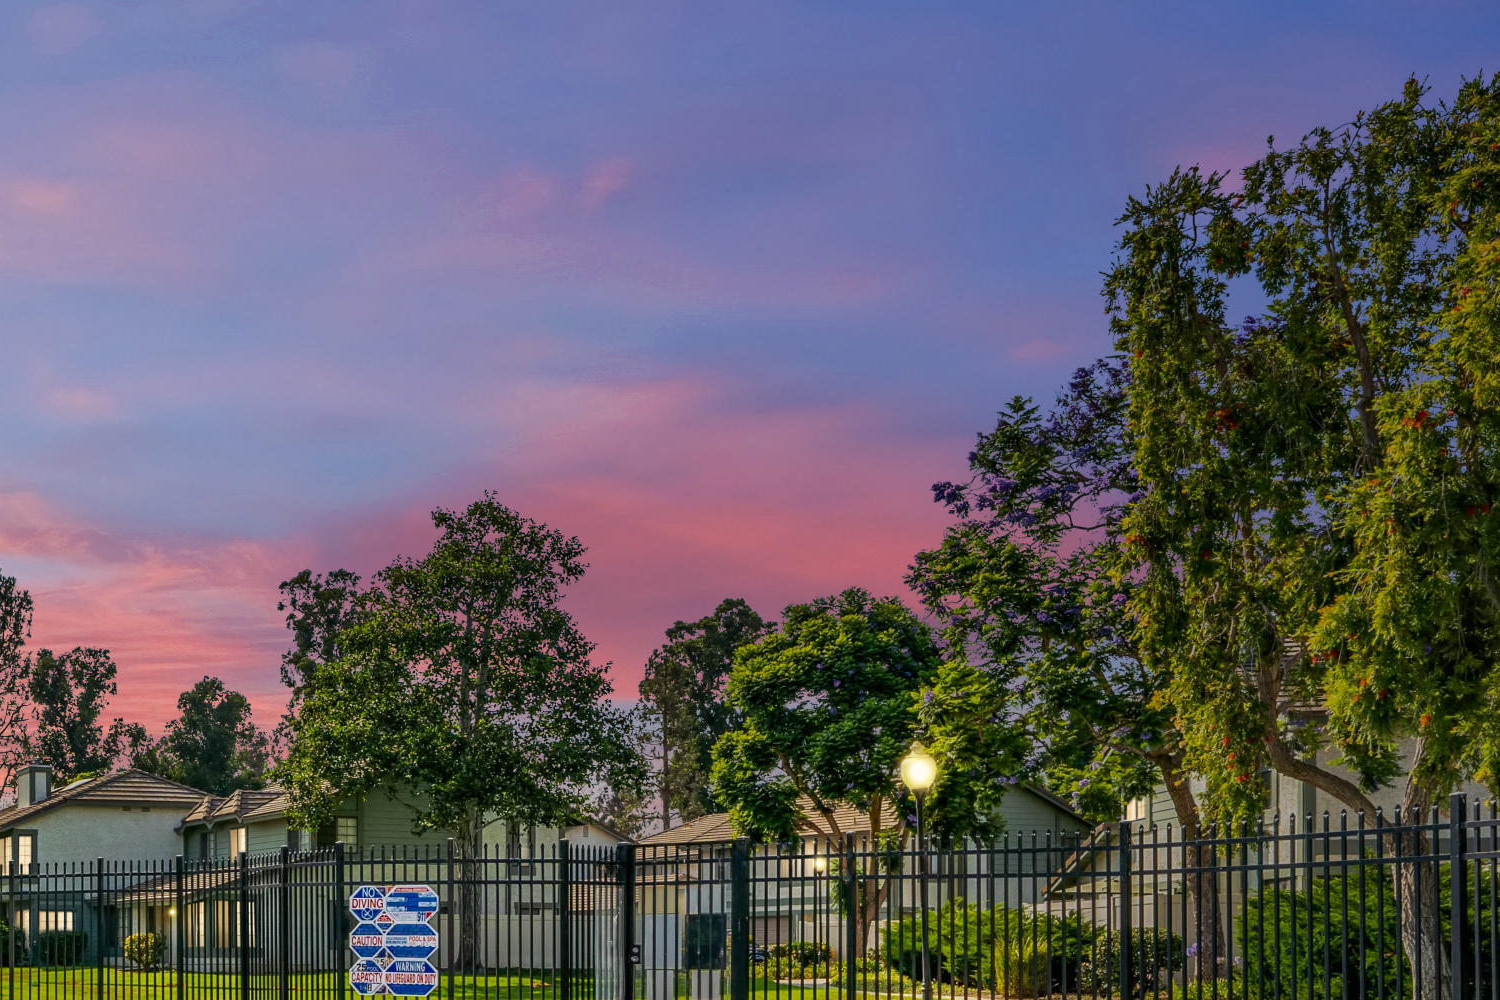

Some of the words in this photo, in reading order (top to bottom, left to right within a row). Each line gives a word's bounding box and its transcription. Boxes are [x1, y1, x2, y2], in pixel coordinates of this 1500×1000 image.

[362, 888, 376, 898] NO
[352, 899, 384, 908] DIVING
[351, 936, 383, 946] CAUTION
[396, 962, 426, 972] WARNING
[351, 972, 383, 983] CAPACITY
[385, 973, 392, 983] NO
[392, 973, 416, 984] LIFEGUARD
[416, 973, 424, 984] ON
[425, 974, 436, 984] DUTY
